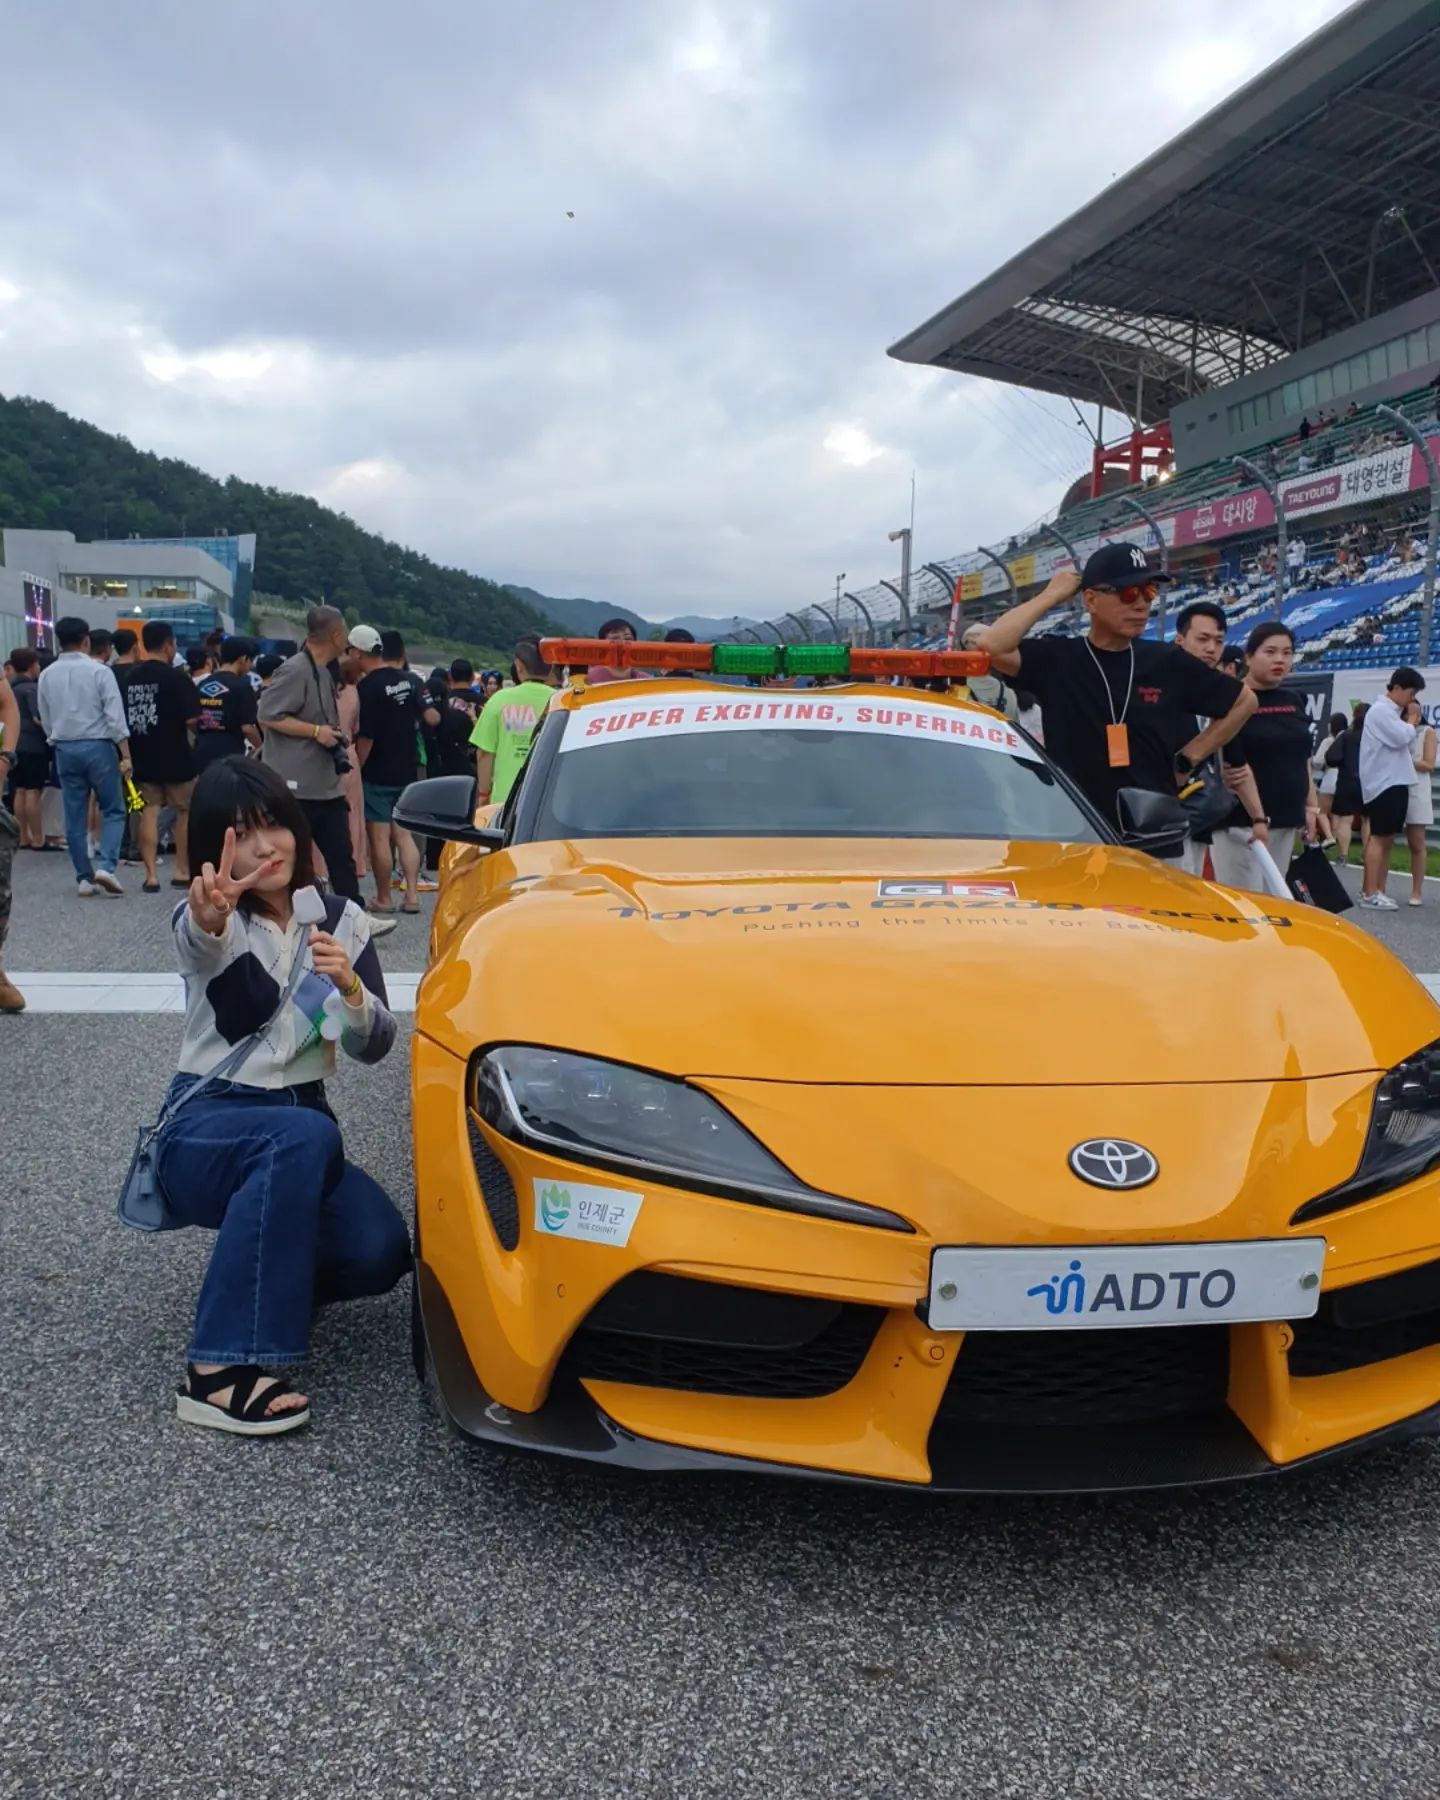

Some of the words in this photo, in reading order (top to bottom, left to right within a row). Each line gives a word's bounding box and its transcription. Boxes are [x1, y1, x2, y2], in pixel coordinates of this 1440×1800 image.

[1286, 482, 1336, 506] TAEYOUNG
[585, 707, 685, 737] SUPER
[694, 703, 844, 724] EXCITING,
[855, 707, 1019, 748] SUPERRACE
[607, 899, 851, 921] TOYOTA
[1101, 902, 1293, 928] Racing
[882, 916, 926, 926] the
[944, 916, 1029, 927] limits
[1048, 917, 1084, 928] for
[578, 1200, 626, 1226] 인제군
